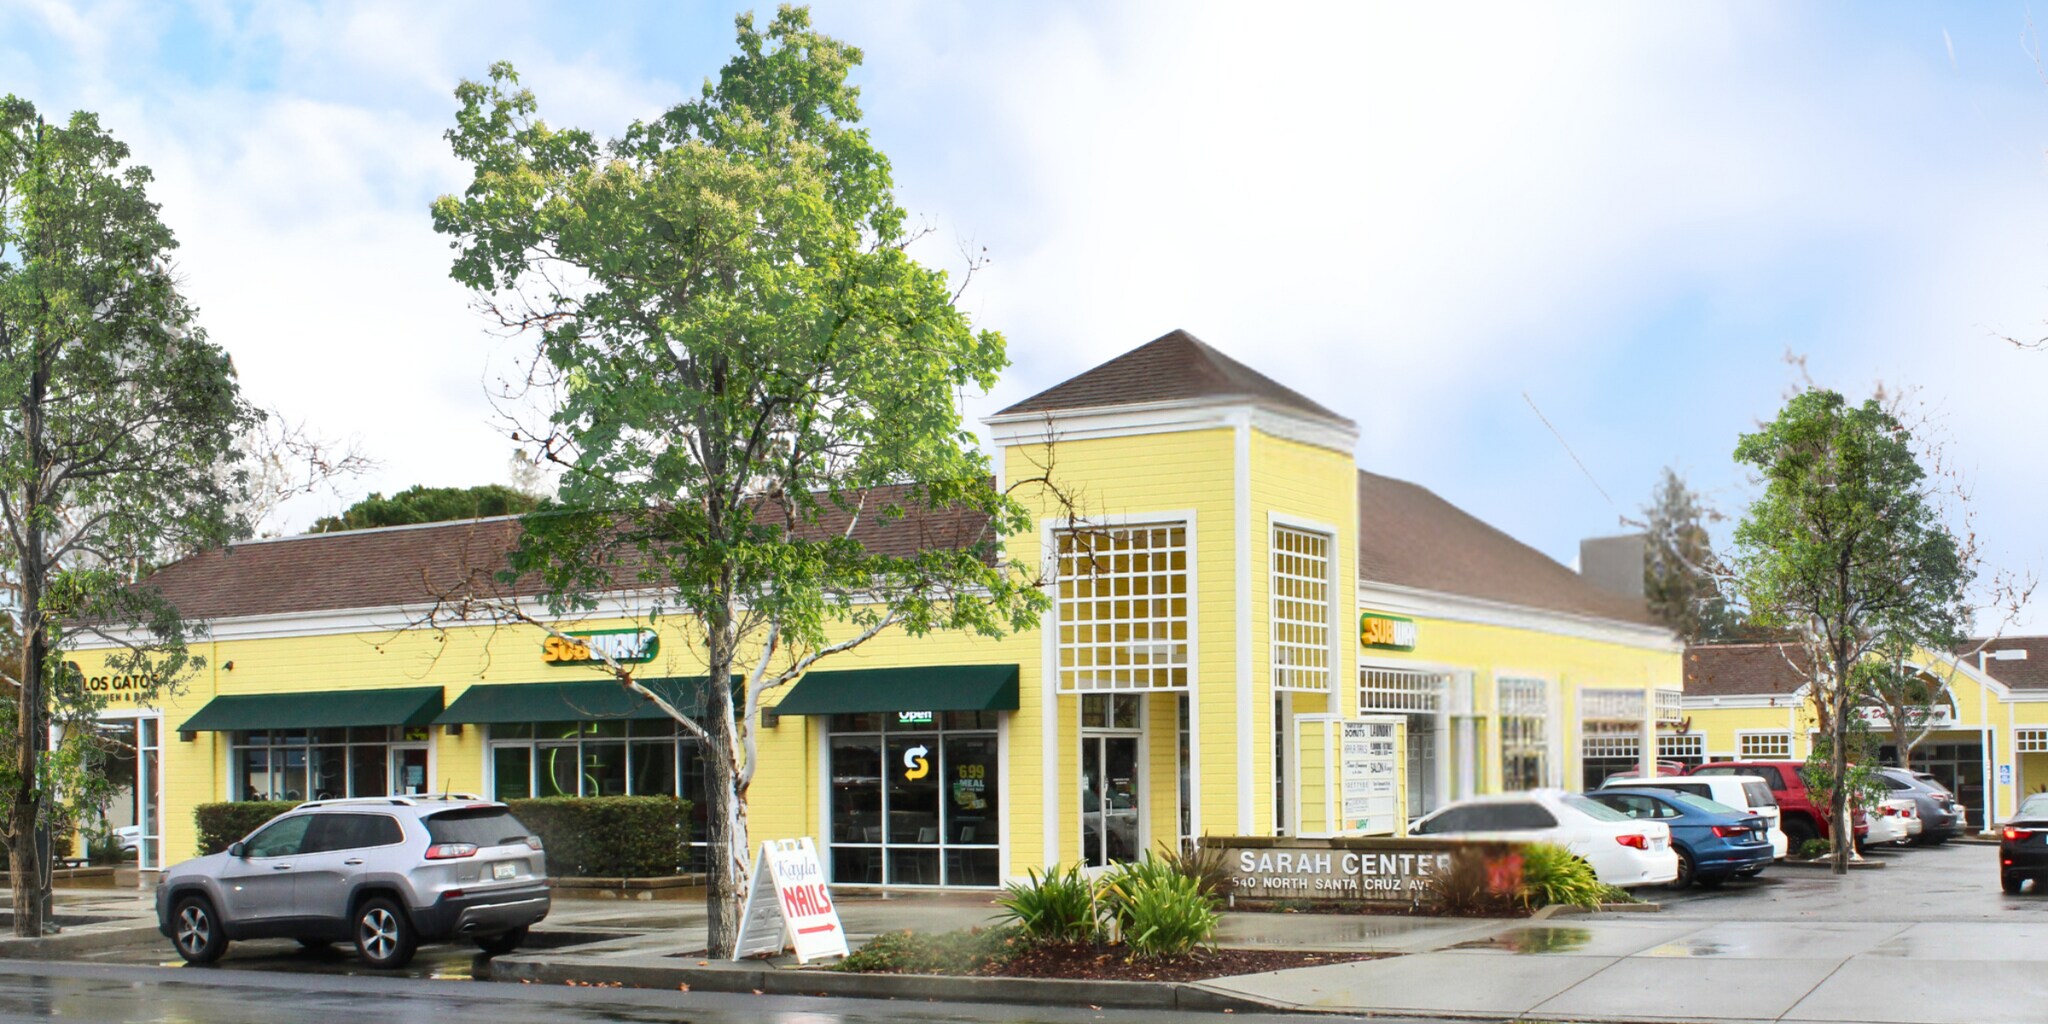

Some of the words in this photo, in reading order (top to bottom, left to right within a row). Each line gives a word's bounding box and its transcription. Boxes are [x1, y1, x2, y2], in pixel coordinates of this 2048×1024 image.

[541, 629, 657, 662] SUBWAY
[83, 676, 108, 691] LOS
[112, 674, 159, 689] GATOS
[899, 711, 932, 722] Open
[960, 779, 984, 788] MEAL
[775, 856, 817, 880] Kayla
[1240, 851, 1331, 874] SARAH
[1341, 853, 1452, 875] CENTER
[1232, 876, 1256, 888] 540
[1263, 877, 1308, 889] NORTH
[1315, 878, 1358, 890] SANTA
[1364, 879, 1401, 890] CRUZ
[783, 883, 832, 918] NAILS
